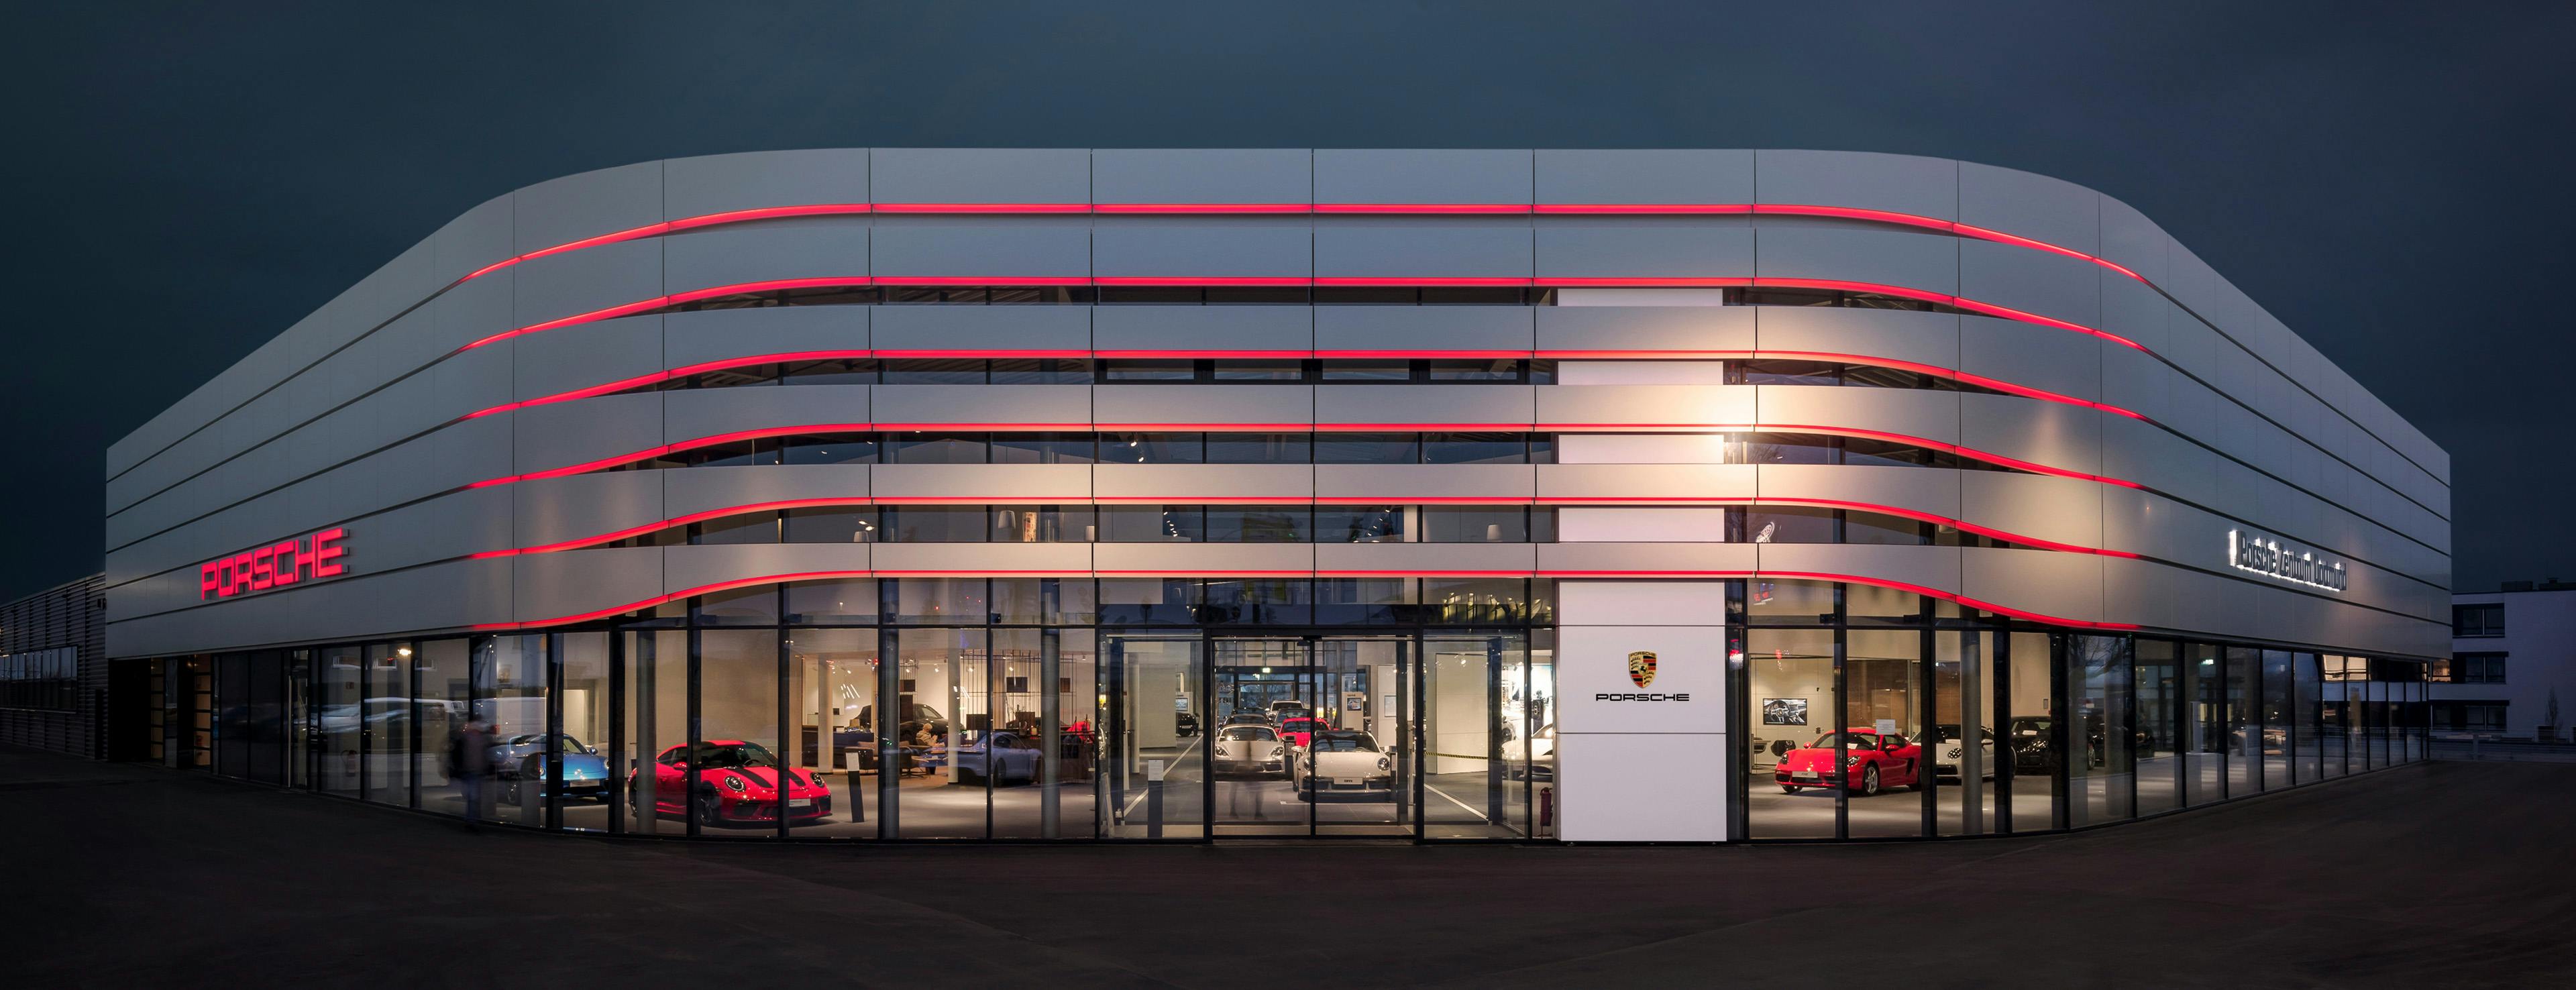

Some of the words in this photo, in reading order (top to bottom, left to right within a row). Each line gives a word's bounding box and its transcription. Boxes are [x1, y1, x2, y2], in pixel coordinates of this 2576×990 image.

[202, 527, 343, 600] PORSCHE
[2239, 532, 2277, 574] Porsche
[2279, 544, 2311, 583] Zentrum
[2314, 554, 2347, 590] Dortmund
[1595, 694, 1690, 702] PORSCHE
